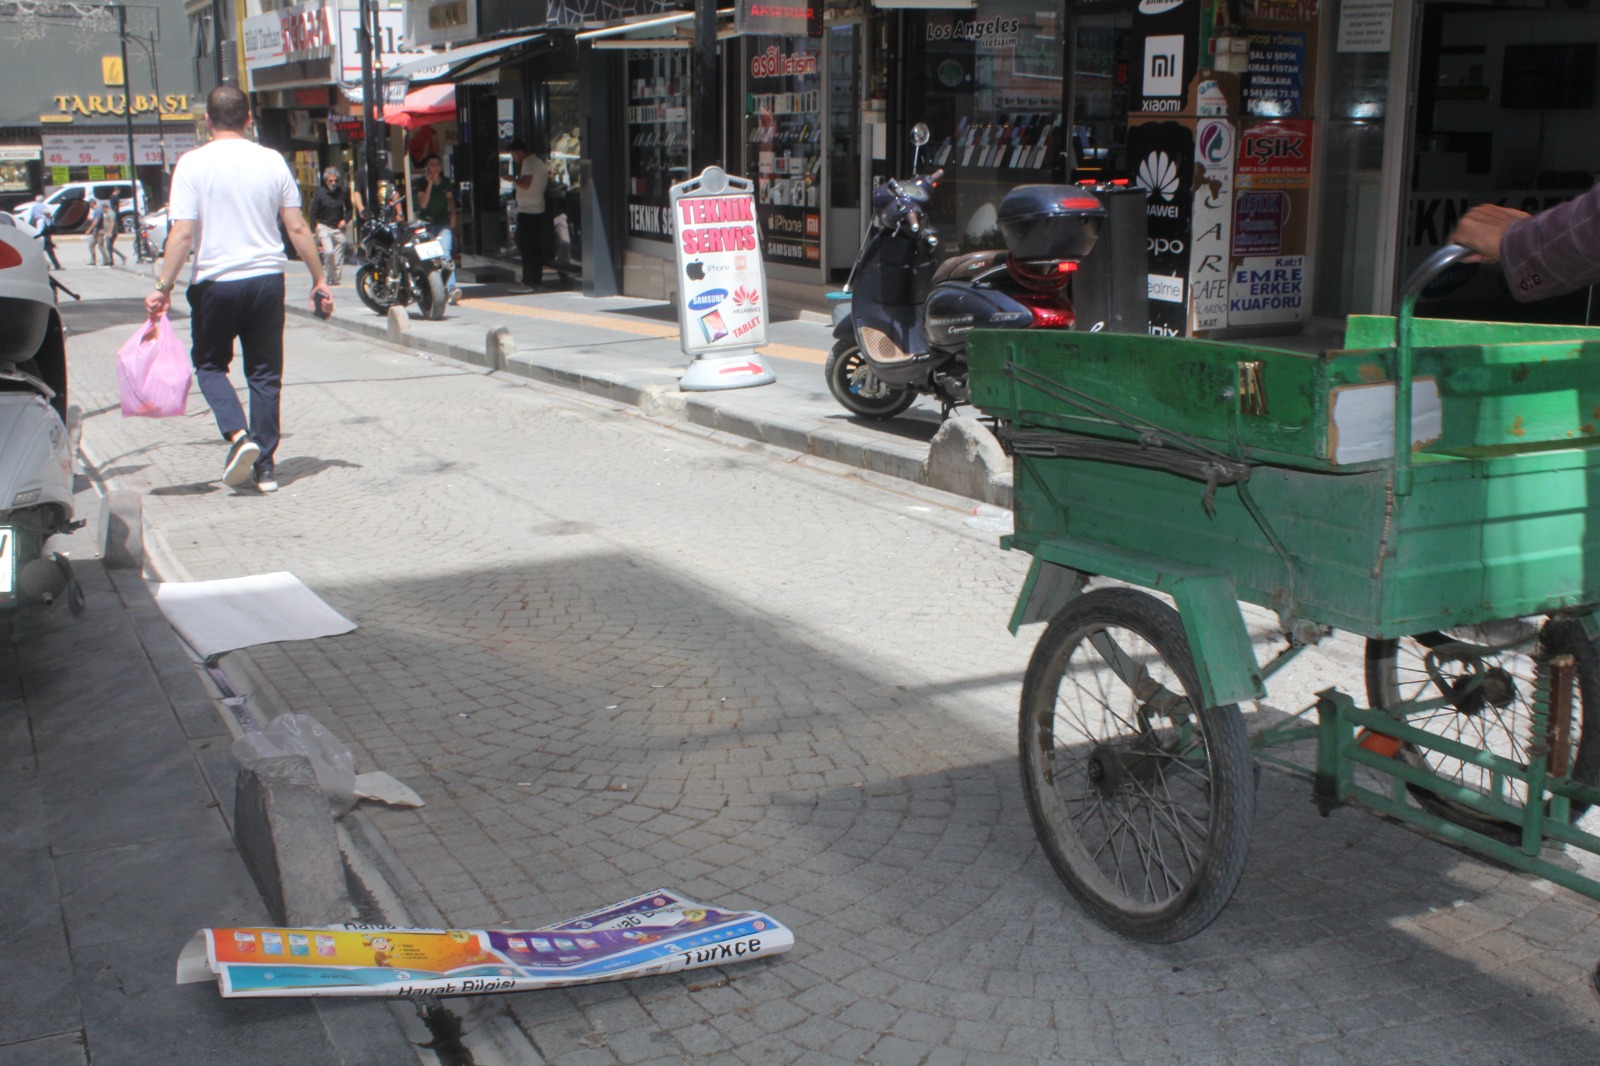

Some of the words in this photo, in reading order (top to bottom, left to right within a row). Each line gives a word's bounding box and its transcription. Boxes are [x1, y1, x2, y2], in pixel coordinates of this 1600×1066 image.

[926, 22, 951, 40] Los
[953, 15, 1019, 39] Angeles
[49, 153, 63, 163] 49
[79, 153, 92, 163] 59
[1246, 137, 1304, 165] IŞIK
[774, 217, 802, 233] iPhone
[768, 242, 803, 259] SAMSUNG
[1237, 269, 1302, 283] EMRE
[1193, 279, 1226, 300] CAFE
[1250, 282, 1302, 296] ERKEK
[693, 291, 725, 304] SAMSUNG
[733, 307, 760, 315] HUAWEI
[732, 316, 761, 338] TABLET
[678, 937, 762, 966] Türkçe
[461, 977, 516, 994] Bilgisi
